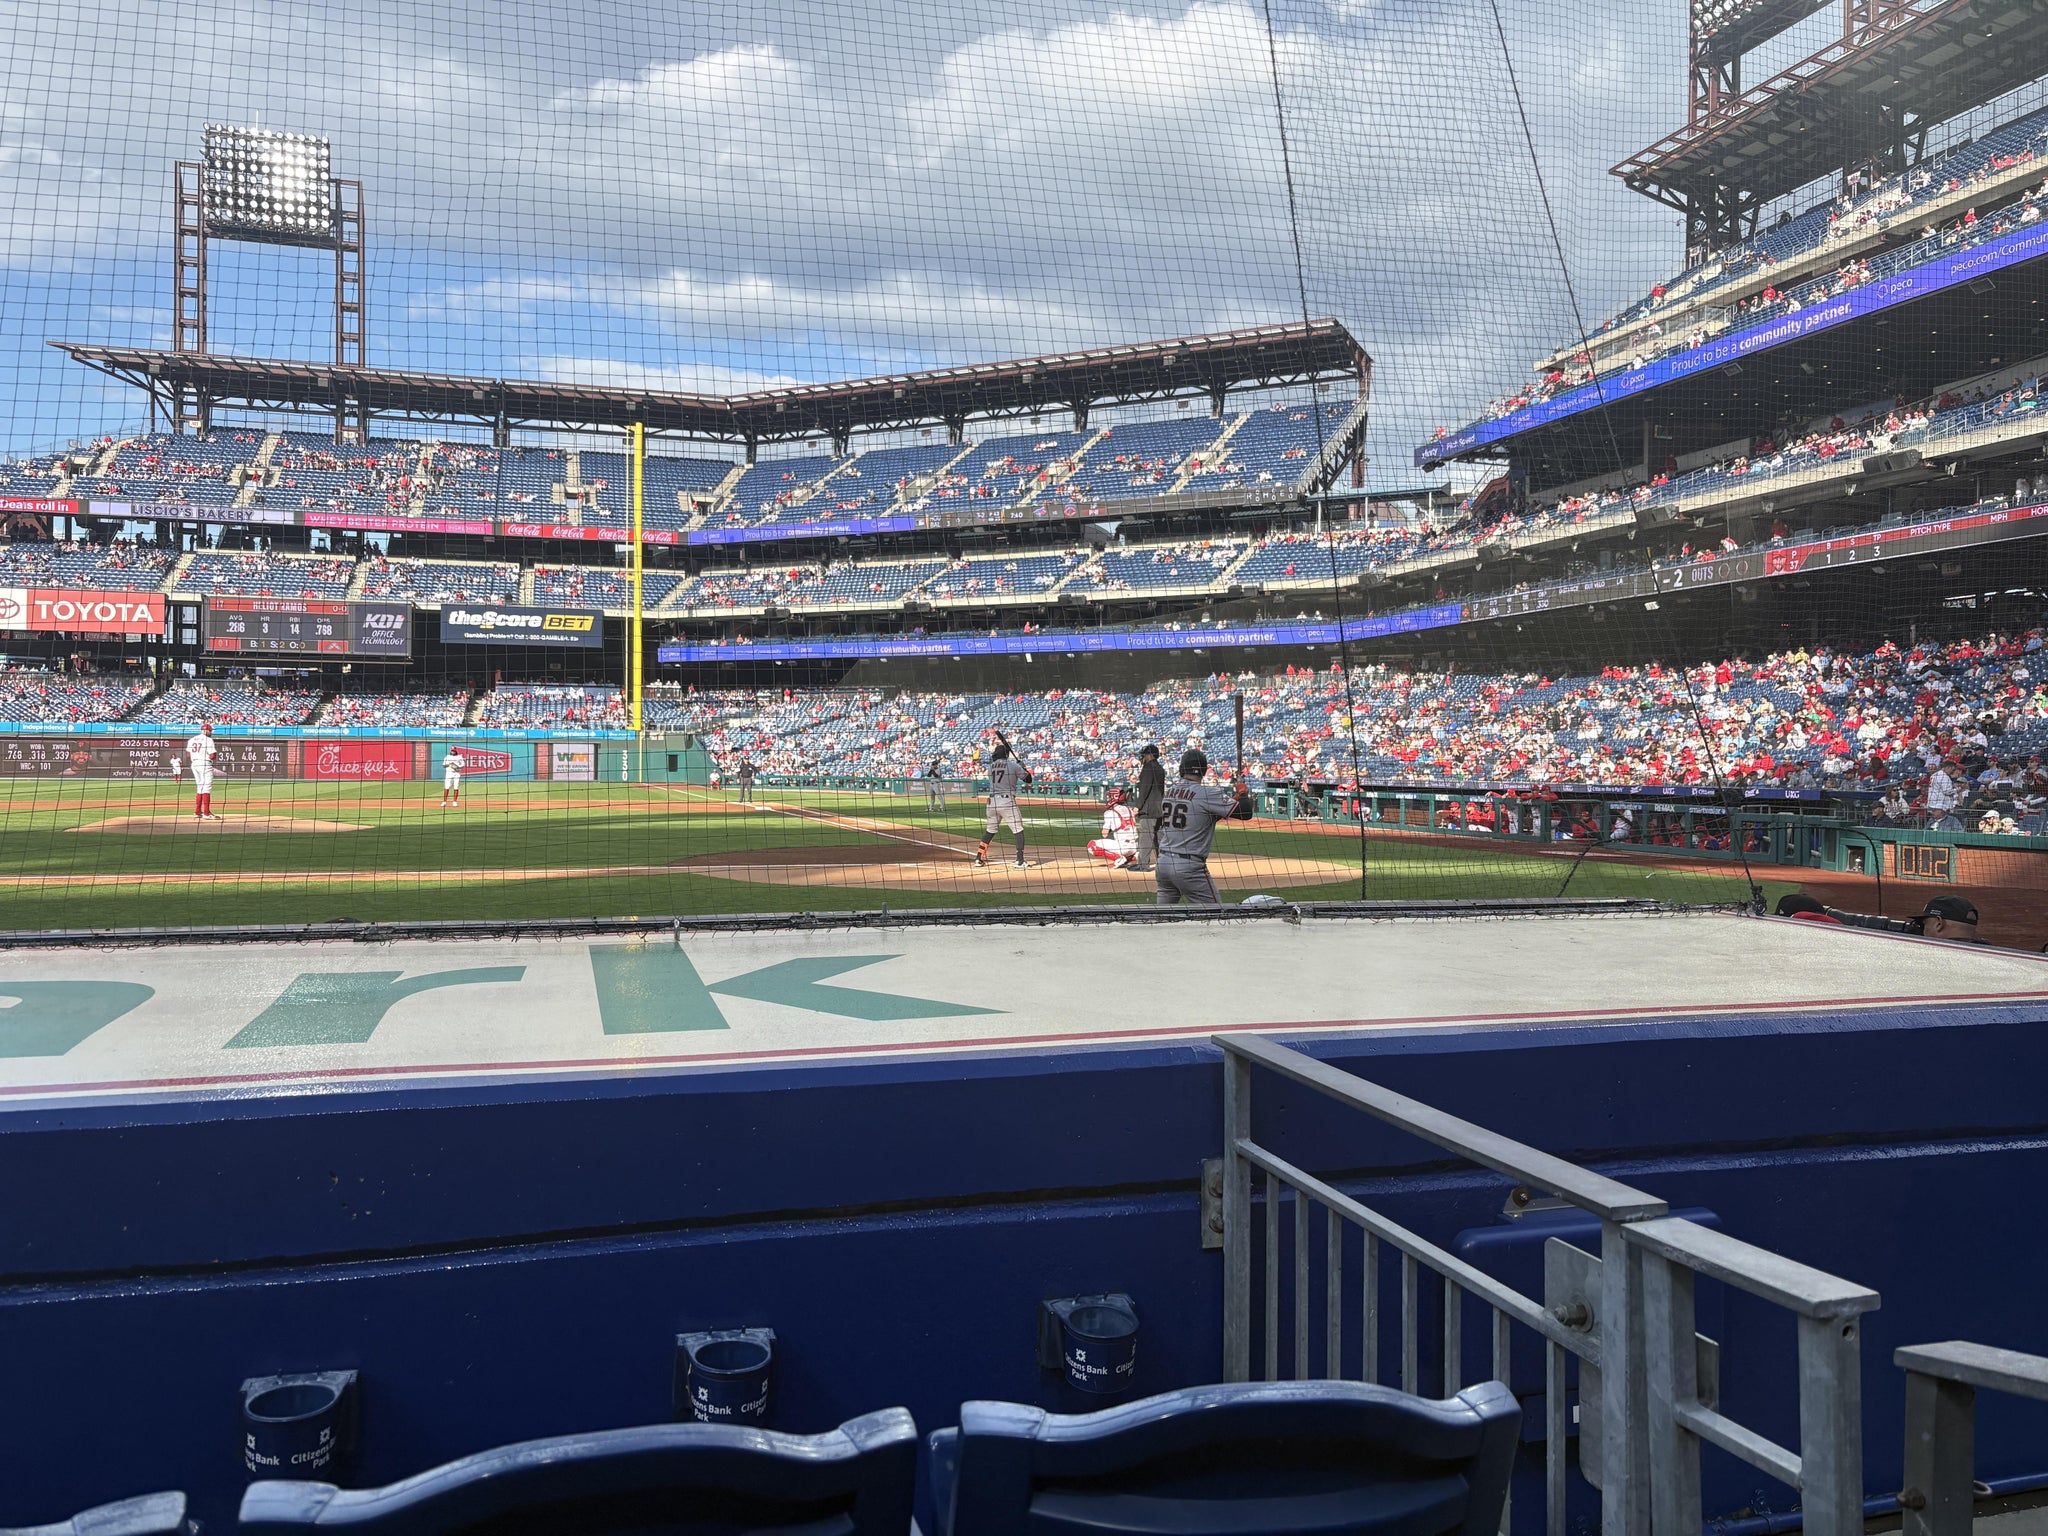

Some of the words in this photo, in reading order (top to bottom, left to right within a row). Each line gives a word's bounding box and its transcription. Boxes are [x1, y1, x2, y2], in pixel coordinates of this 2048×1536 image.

[1890, 277, 1913, 294] peco
[1671, 355, 1701, 374] Proud
[1703, 351, 1713, 363] to
[1715, 345, 1728, 359] be
[1731, 343, 1737, 352] a
[1739, 320, 1802, 352] community
[1805, 302, 1853, 330] partner.
[36, 500, 55, 511] roll
[58, 502, 69, 512] in
[131, 503, 192, 517] LISCIO'S
[197, 508, 253, 520] BAKERY
[310, 515, 345, 526] WHEY
[348, 516, 389, 528] BETTER
[392, 519, 440, 530] PROTEIN
[745, 530, 764, 540] Proud
[1826, 542, 1832, 551] B
[1850, 537, 1856, 546] S
[1873, 533, 1882, 543] TP
[1910, 526, 1932, 536] PITCH
[1933, 522, 1952, 533] TYPE
[1990, 512, 2009, 523] MPH
[1791, 550, 1798, 559] P
[1826, 554, 1831, 565] 1
[1849, 550, 1856, 562] 2
[1873, 545, 1881, 557] 3
[1789, 560, 1800, 571] 37
[1691, 566, 1714, 582] OUTS
[34, 600, 153, 622] TOYOTA
[362, 613, 406, 629] KDI
[547, 616, 590, 628] BET
[262, 622, 269, 634] 3
[290, 623, 300, 634] 14
[371, 629, 395, 639] OFFICE
[1308, 629, 1325, 638] peco
[279, 641, 286, 649] 2
[360, 637, 405, 646] TECHNOLOGY
[1127, 635, 1152, 646] Proud
[1154, 636, 1163, 645] to
[1166, 634, 1175, 645] be
[1186, 633, 1236, 646] community
[1238, 632, 1275, 645] partner.
[880, 643, 922, 654] community
[22, 724, 67, 732] Independence
[120, 739, 142, 748] 2026
[143, 740, 170, 748] STATS
[191, 742, 202, 753] 37
[5, 751, 22, 760] .768
[28, 751, 46, 760] .318
[52, 751, 70, 760] .339
[129, 750, 160, 758] RAMOS
[218, 753, 235, 762] 3.94
[318, 744, 400, 776] Chick-fil-A
[40, 762, 52, 771] 101
[130, 759, 159, 767] MAYZA
[991, 769, 1005, 784] 17
[1785, 790, 1800, 798] UKG
[1162, 802, 1189, 830] 26
[1071, 1368, 1088, 1382] Park
[1086, 1365, 1108, 1376] Bank
[694, 1408, 709, 1423] Park
[708, 1404, 732, 1416] Bank
[255, 1453, 280, 1466] Bank
[290, 1444, 329, 1465] Citizens
[313, 1452, 330, 1469] Park
